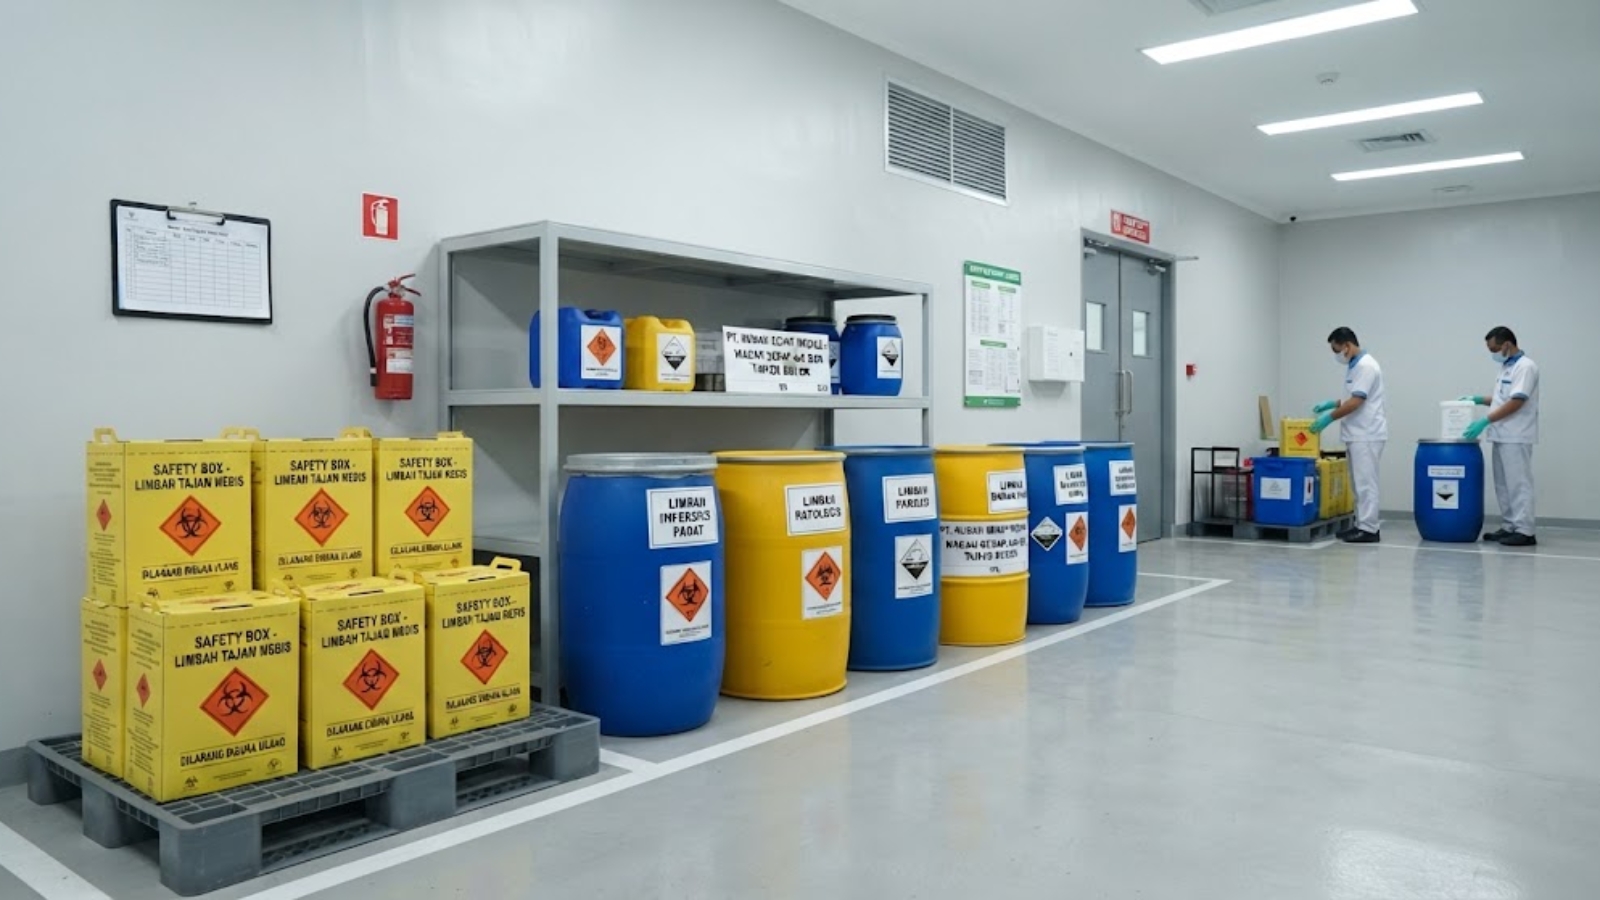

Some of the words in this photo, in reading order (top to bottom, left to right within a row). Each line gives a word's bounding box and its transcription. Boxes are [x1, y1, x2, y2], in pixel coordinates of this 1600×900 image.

[153, 462, 198, 476] SAFETY
[399, 457, 434, 468] SAFETY
[337, 614, 378, 632] SAFETY
[194, 631, 243, 650] SAFETY
[246, 628, 271, 644] BOX
[222, 645, 258, 662] TAJAN
